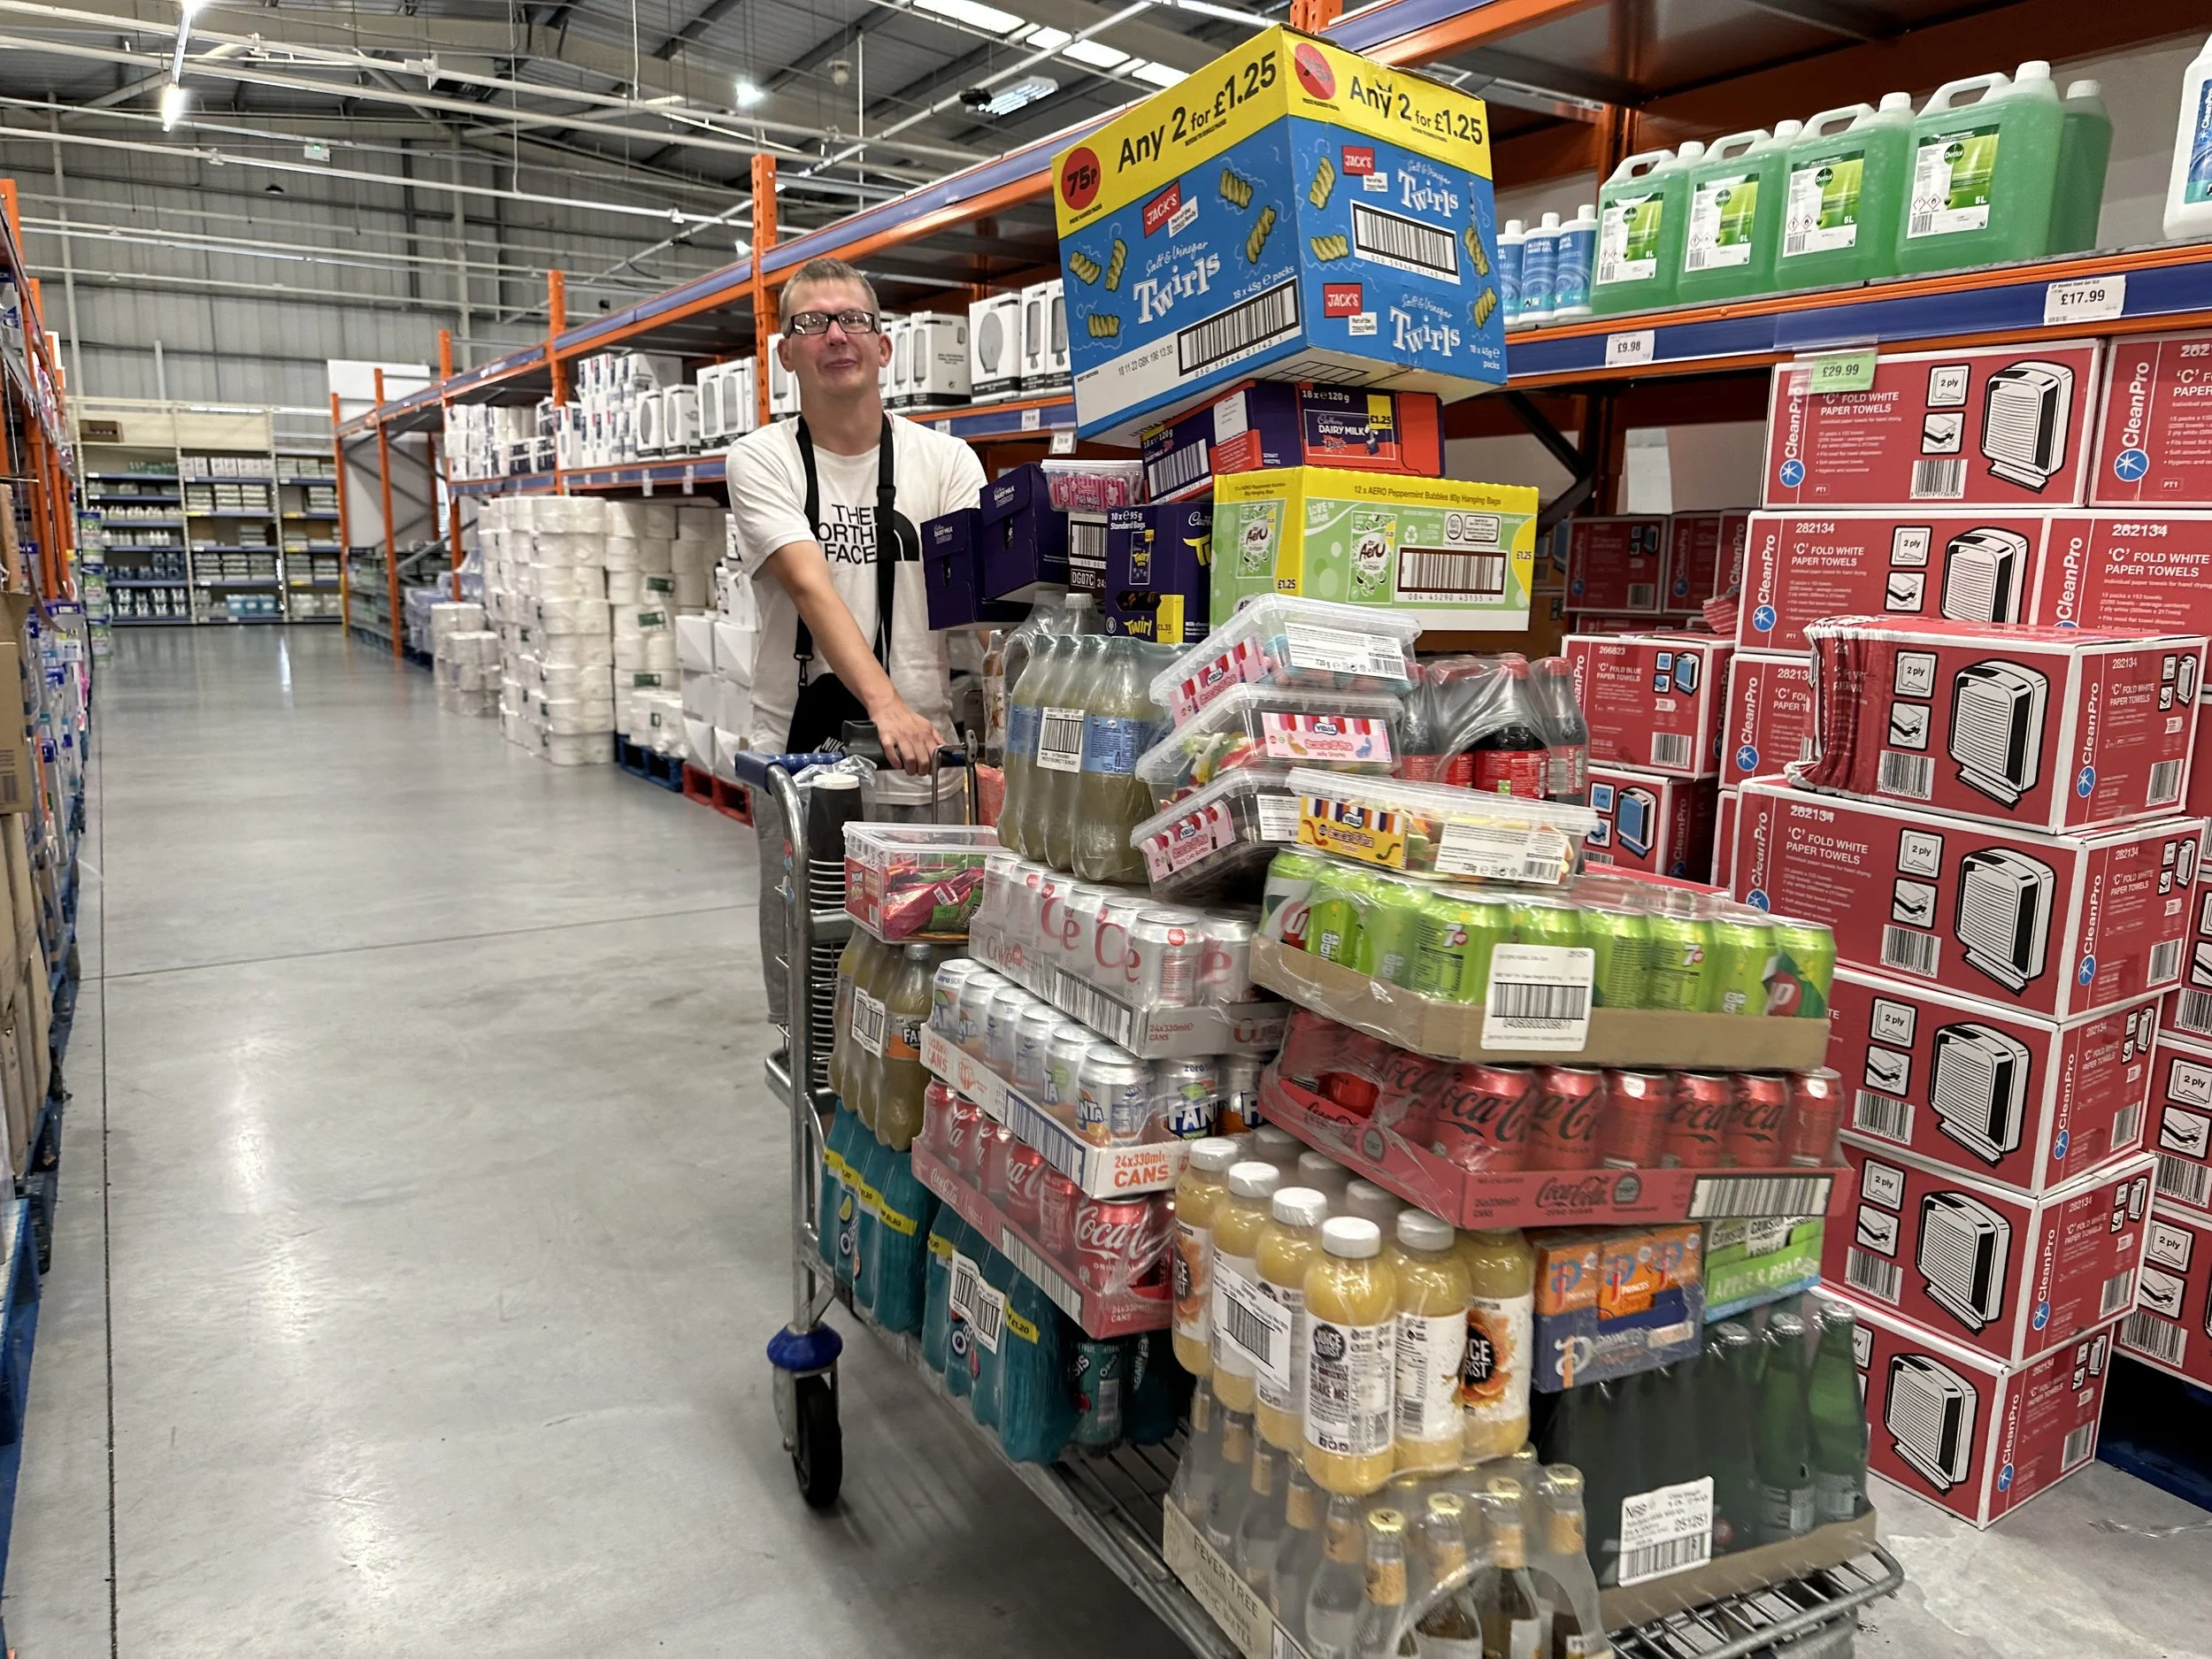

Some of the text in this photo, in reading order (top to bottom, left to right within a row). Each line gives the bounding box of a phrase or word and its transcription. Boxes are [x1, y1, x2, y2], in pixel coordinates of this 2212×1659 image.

[1118, 125, 1165, 173] Any
[1171, 106, 1187, 142] 2
[1191, 106, 1211, 132] for
[1213, 50, 1278, 119] £1.25
[1349, 75, 1392, 119] Any
[1398, 94, 1411, 119] 2
[1415, 109, 1431, 130] for
[1434, 109, 1483, 145] £1.25
[1345, 154, 1372, 168] JACK'S
[1066, 165, 1097, 197] 75p
[1398, 168, 1458, 218] Twirls
[1147, 193, 1179, 226] JACK'S
[1171, 242, 1208, 261] Vinegar
[1133, 252, 1221, 325] Twirls
[1233, 265, 1295, 300] 18 packs
[1327, 293, 1359, 308] JACK'S
[2061, 289, 2105, 305] £17.99
[1390, 305, 1461, 357] Twirls
[1617, 341, 1641, 354] £9.98
[1195, 365, 1210, 377] 050
[1822, 364, 1859, 378] £29.99
[1947, 379, 1959, 388] ply
[1302, 389, 1312, 399] 18
[1328, 390, 1343, 401] 120
[1344, 394, 1349, 403] g
[1841, 391, 1900, 403] FOLD WHITE
[1821, 403, 1892, 416] PAPER TOWELS
[2123, 361, 2150, 448] CleanPro
[1370, 415, 1392, 426] £1.25
[1318, 425, 1364, 436] DAIRY MILK
[1369, 487, 1386, 496] AERO
[1387, 488, 1424, 500] Peppermint
[1425, 492, 1448, 502] Bubbles
[1461, 495, 1485, 507] Hanging
[1486, 498, 1502, 507] Bags
[832, 504, 872, 526] THE
[1309, 502, 1326, 517] LOVE
[1110, 521, 1133, 530] Standard
[1795, 523, 1835, 534] 282134
[2112, 524, 2168, 537] 282134
[819, 524, 875, 545] ORTH
[1811, 547, 1834, 556] FOLD
[1836, 546, 1864, 556] WHITE
[1910, 540, 1922, 549] ply
[825, 544, 877, 565] FACE
[1517, 550, 1532, 560] £1.25
[1792, 557, 1857, 567] PAPER TOWELS
[2133, 552, 2166, 564] FOLD
[2170, 553, 2210, 565] WHITE
[1758, 534, 1776, 603] CleanPro
[2105, 565, 2200, 578] PAPER TOWELS
[1072, 572, 1094, 588] DG07C
[1278, 579, 1296, 589] £1.25
[2056, 537, 2083, 619] CleanPro
[1123, 615, 1152, 636] Twirl
[1599, 646, 1625, 656] 266823
[2112, 657, 2137, 669] 282134
[1914, 667, 1925, 677] ply
[2123, 683, 2154, 694] FOLD WHITE
[1773, 702, 1801, 710] PAPER
[2110, 694, 2150, 707] PAPER TOWELS
[1741, 677, 1757, 743] CleanPro
[2083, 682, 2099, 764] CleanPro
[1790, 805, 1835, 823] 282134
[1752, 811, 1768, 887] CleanPro
[1808, 833, 1833, 847] FOLD
[1836, 839, 1869, 855] WHITE
[1786, 841, 1861, 865] PAPER TOWELS
[1919, 847, 1932, 857] ply
[2116, 846, 2139, 861] 282134
[2123, 872, 2137, 884] FOLD
[2110, 881, 2148, 896] PAPER TOWELS
[2085, 874, 2101, 955] CleanPro
[1885, 1013, 1905, 1027] 2 ply
[1150, 1032, 1169, 1041] CANS
[1184, 1064, 1204, 1072] zero
[2192, 1077, 2206, 1088] ply
[2059, 1053, 2075, 1130] CleanPro
[1076, 1101, 1104, 1122] NTA
[1166, 1097, 1215, 1132] FAN
[1115, 1166, 1169, 1187] CANS
[1876, 1176, 1894, 1189] 2 ply
[886, 1212, 902, 1227] £1.20
[2166, 1239, 2180, 1250] ply
[2038, 1229, 2055, 1302] CleanPro
[1010, 1320, 1031, 1334] £1.20
[2003, 1394, 2019, 1464] CleanPro
[1194, 1535, 1258, 1618] FEVER-TREE
